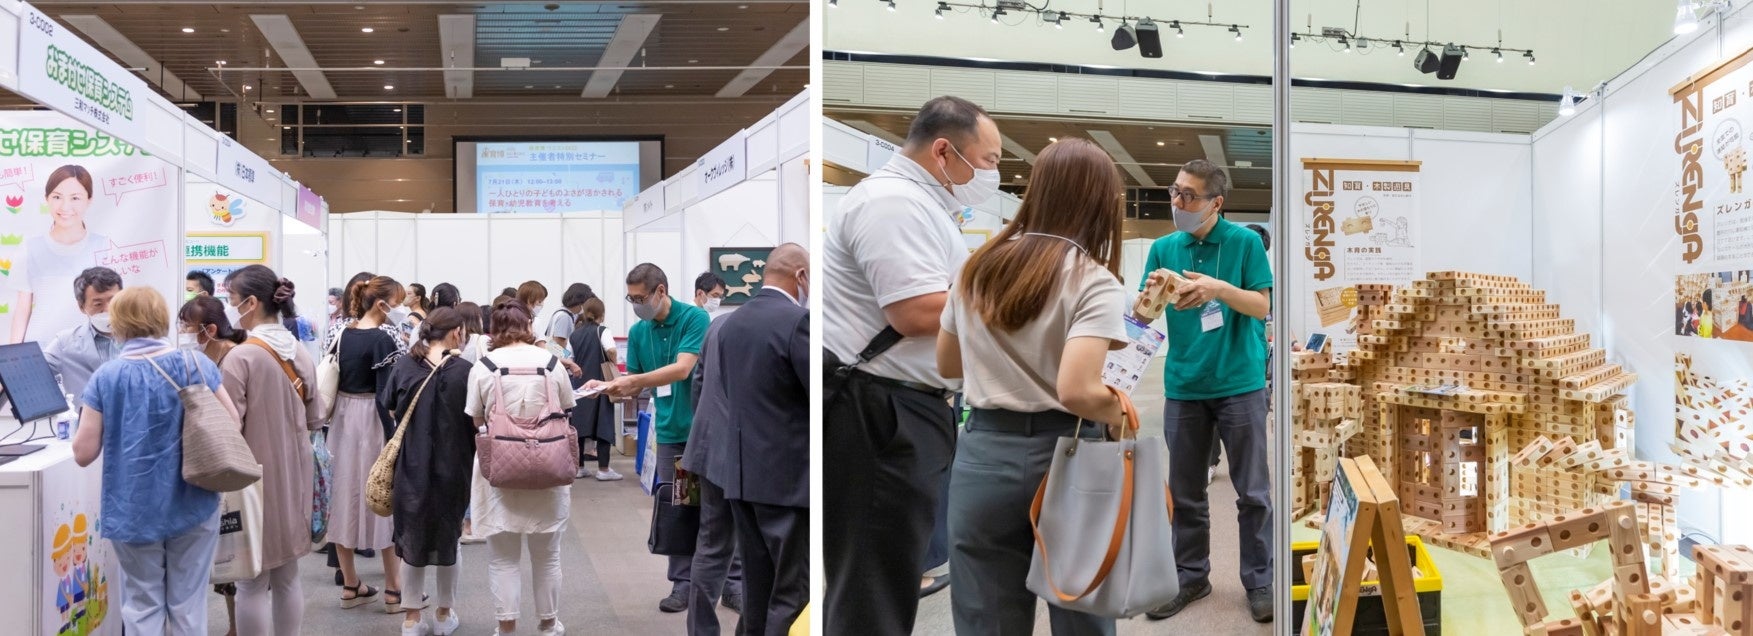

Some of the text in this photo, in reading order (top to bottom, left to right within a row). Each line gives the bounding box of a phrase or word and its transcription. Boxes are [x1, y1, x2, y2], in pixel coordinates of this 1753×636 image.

[46, 44, 134, 121] おまかせ保育システム
[529, 152, 607, 161] 主催者特別セミナー
[102, 248, 159, 266] こんな機能が
